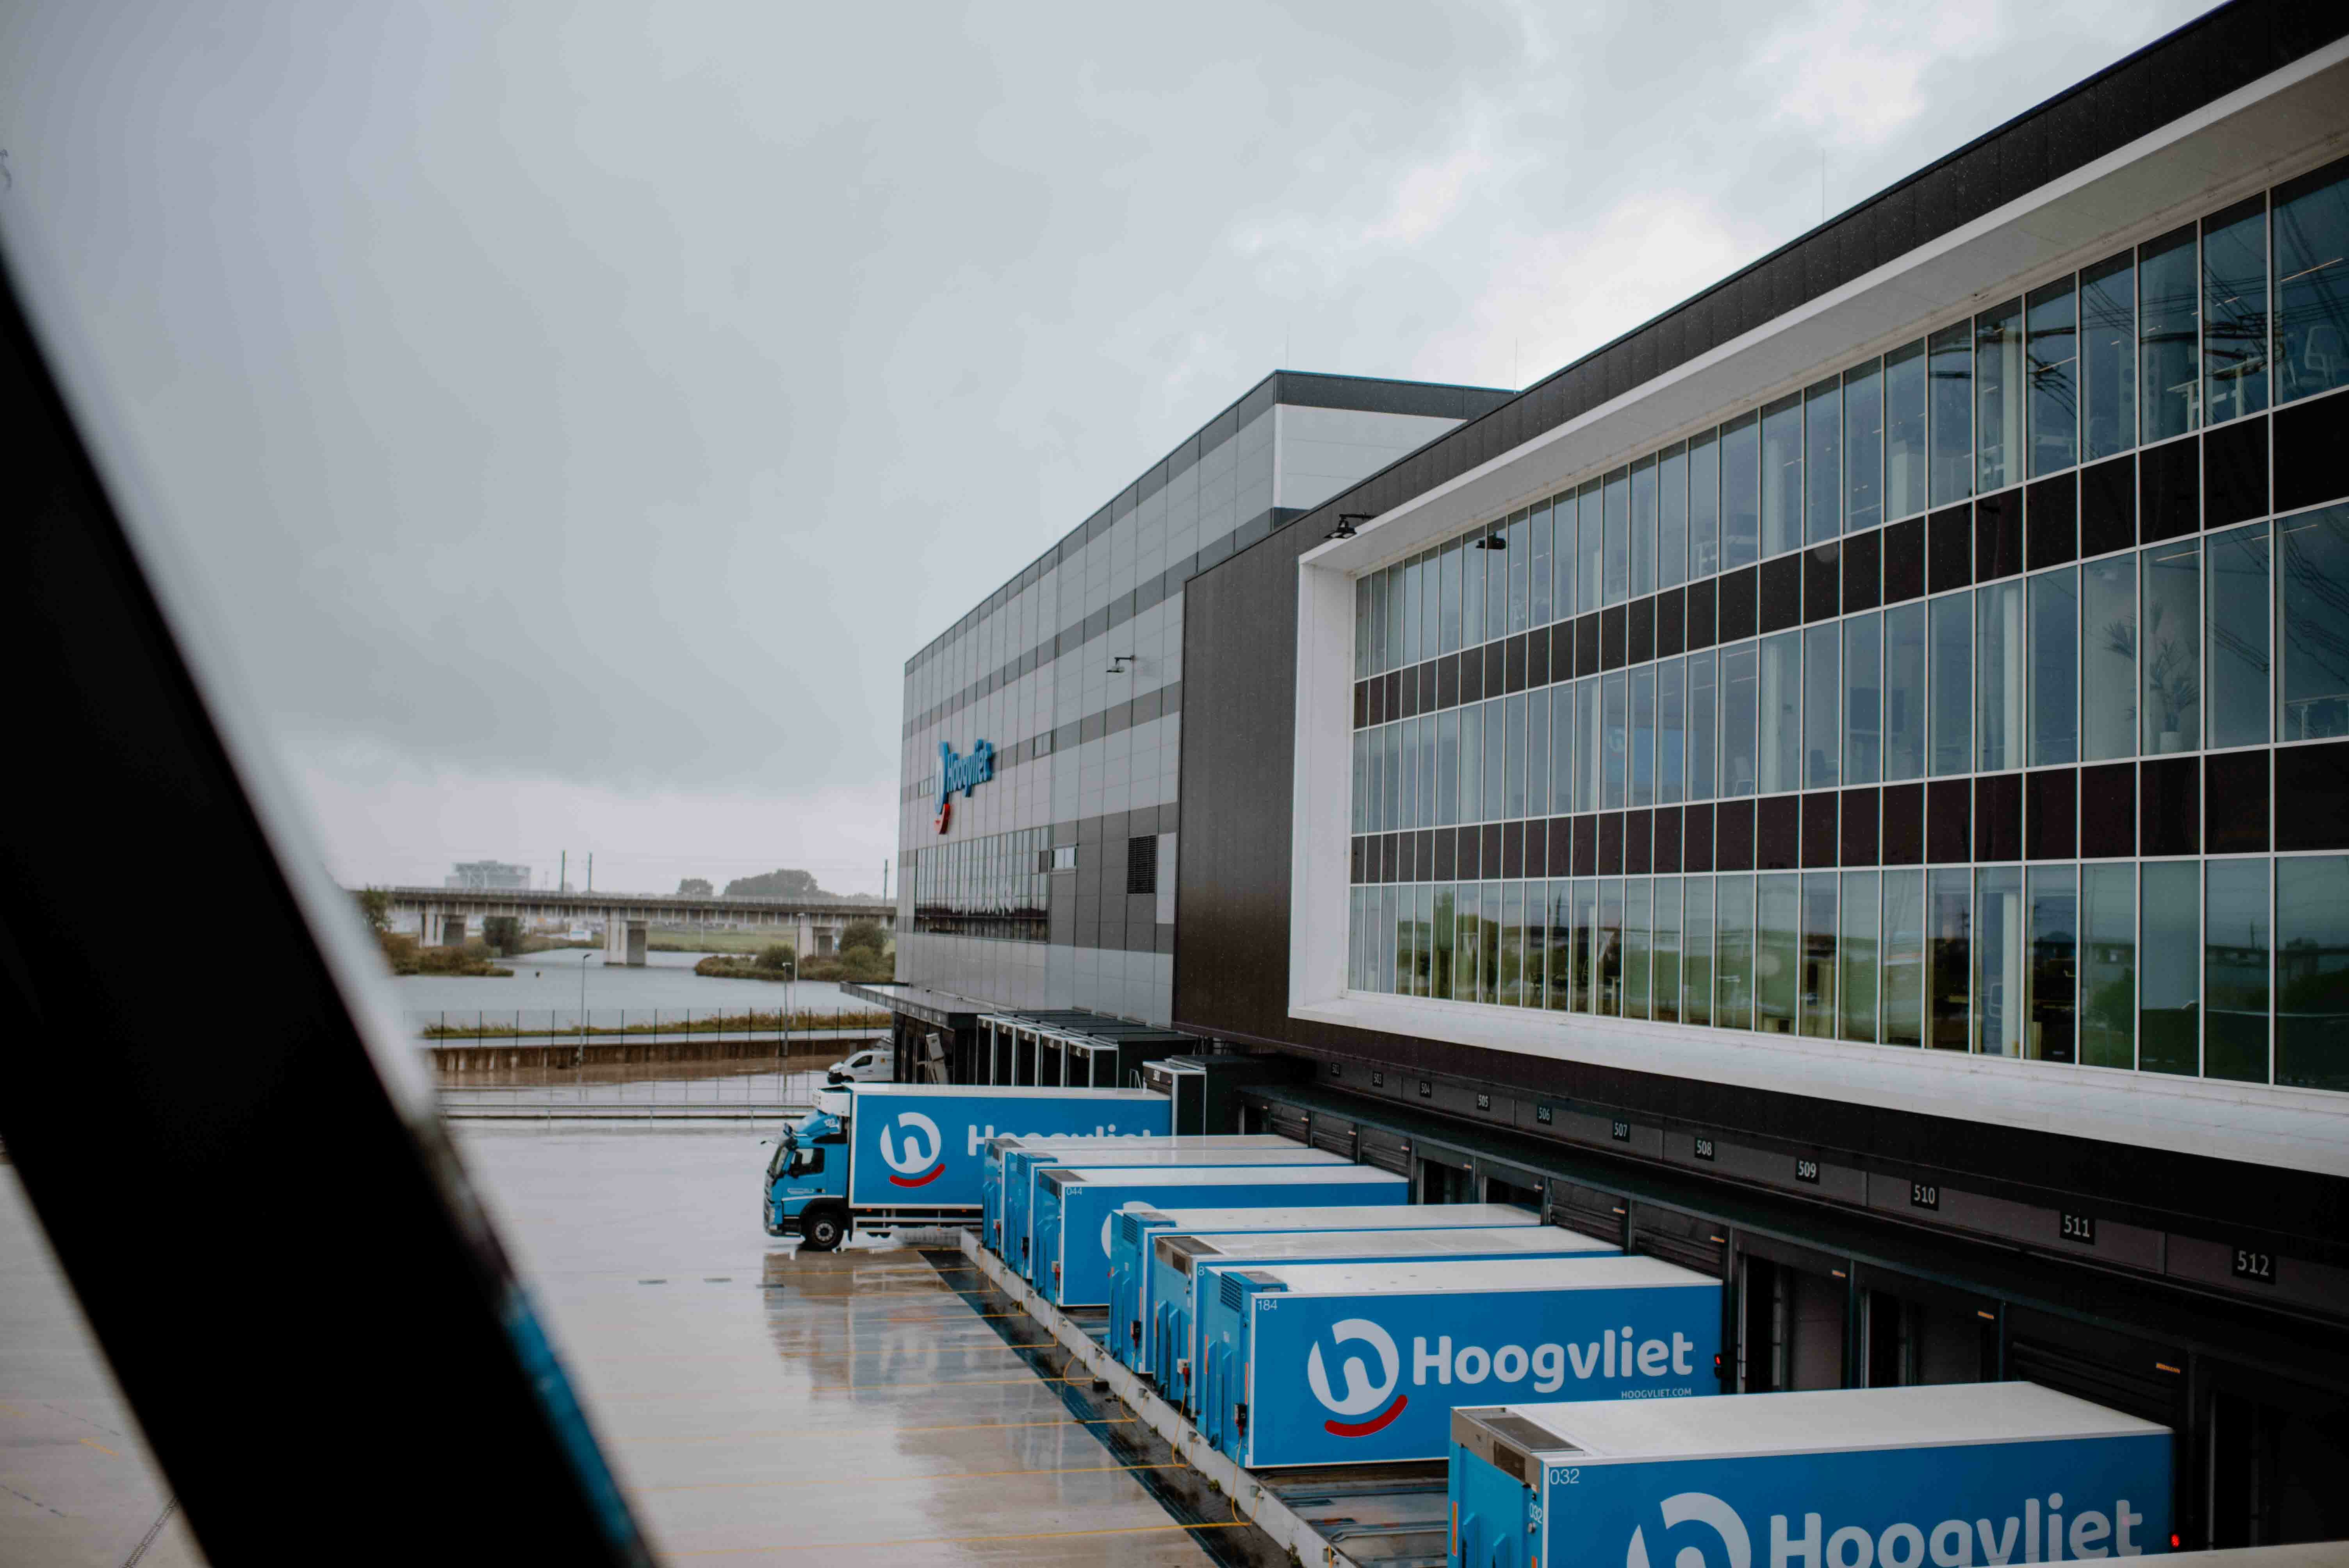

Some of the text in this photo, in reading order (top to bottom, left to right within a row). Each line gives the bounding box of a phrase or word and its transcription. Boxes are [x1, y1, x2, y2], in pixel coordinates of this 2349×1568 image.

[946, 738, 993, 797] Hoogvliet
[1420, 1084, 1431, 1095] 504
[1478, 1095, 1489, 1108] 505
[1538, 1108, 1550, 1121] 506
[1614, 1122, 1627, 1137] 507
[1696, 1140, 1712, 1156] 508
[1798, 1160, 1816, 1179] 509
[1066, 1187, 1083, 1196] 044
[1914, 1184, 1936, 1205] 510
[2064, 1214, 2091, 1238] 511
[2236, 1249, 2270, 1277] 512
[1257, 1299, 1278, 1311] 184
[1413, 1326, 1693, 1393] Hoogvliet
[1621, 1388, 1691, 1399] HOOGVLIET.COM
[1550, 1468, 1579, 1485] 032
[1529, 1502, 1543, 1524] 032
[1770, 1492, 2142, 1568] Hoogvliet
